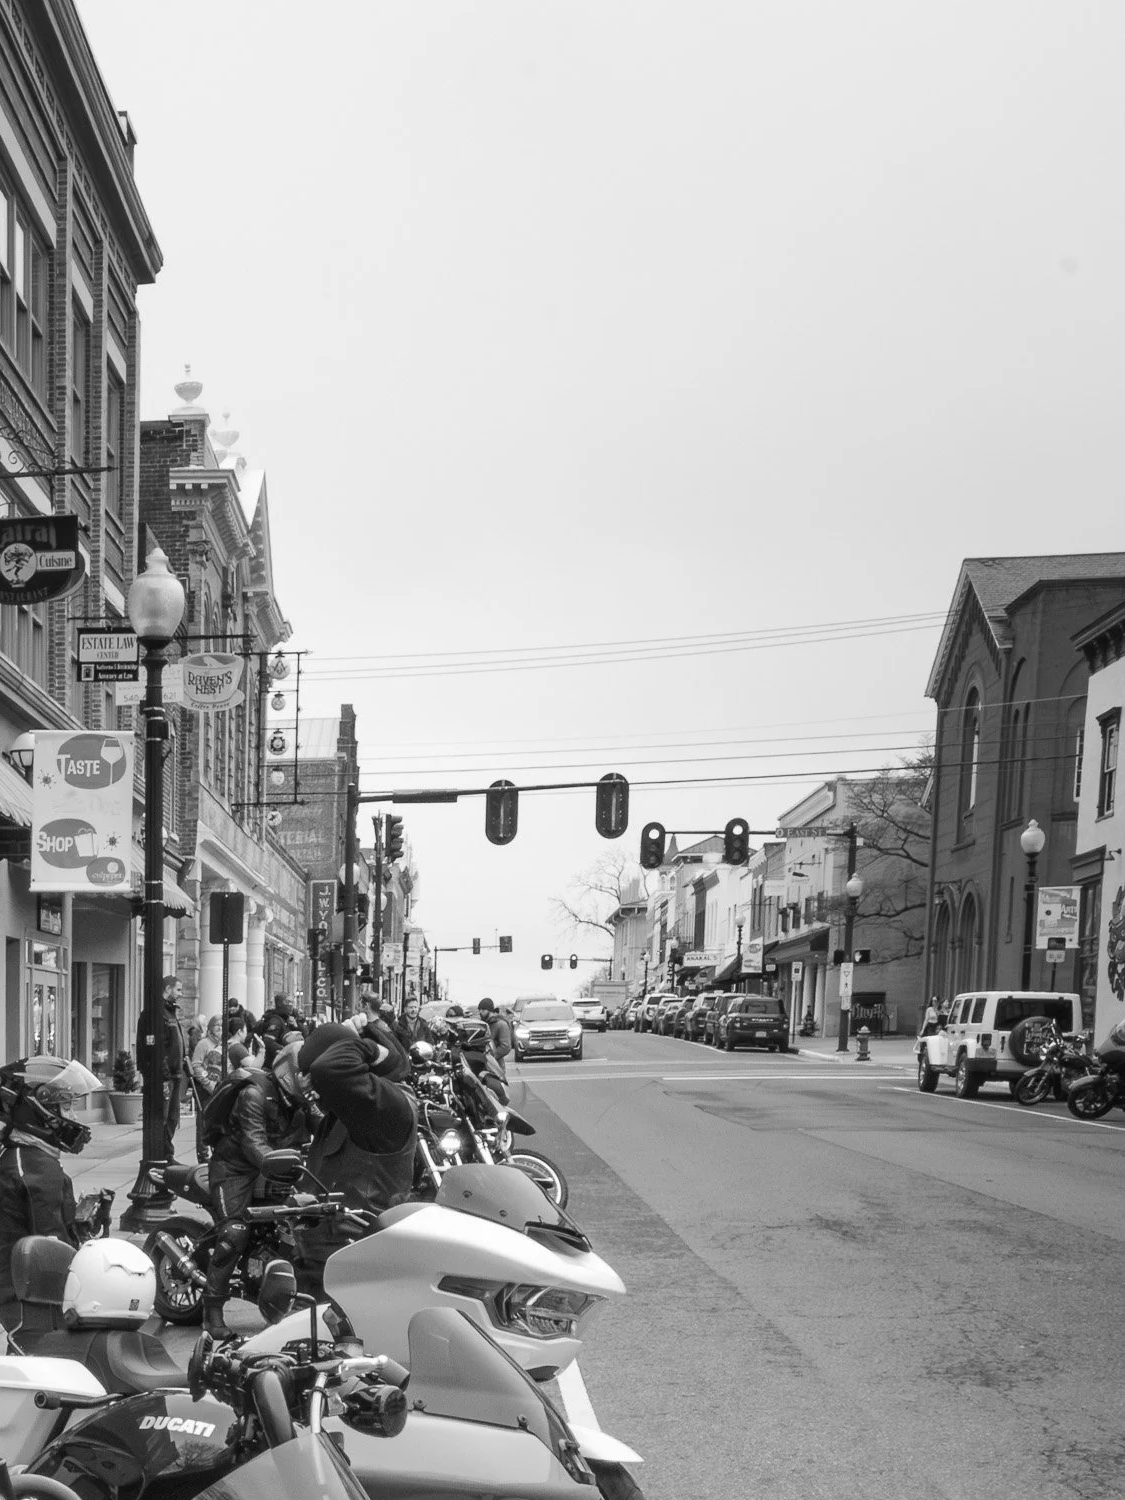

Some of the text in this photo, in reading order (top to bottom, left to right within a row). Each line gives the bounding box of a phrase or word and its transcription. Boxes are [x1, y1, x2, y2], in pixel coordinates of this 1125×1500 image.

[39, 553, 72, 568] Cuisine
[81, 636, 135, 650] ESTATE LAW
[96, 651, 120, 660] CENTER
[188, 671, 233, 688] RAVEN'S
[195, 685, 223, 695] NEST
[56, 754, 101, 779] TASTE
[786, 827, 824, 838] EAST ST
[36, 831, 74, 853] SHOP
[139, 1416, 216, 1437] DUCATI
